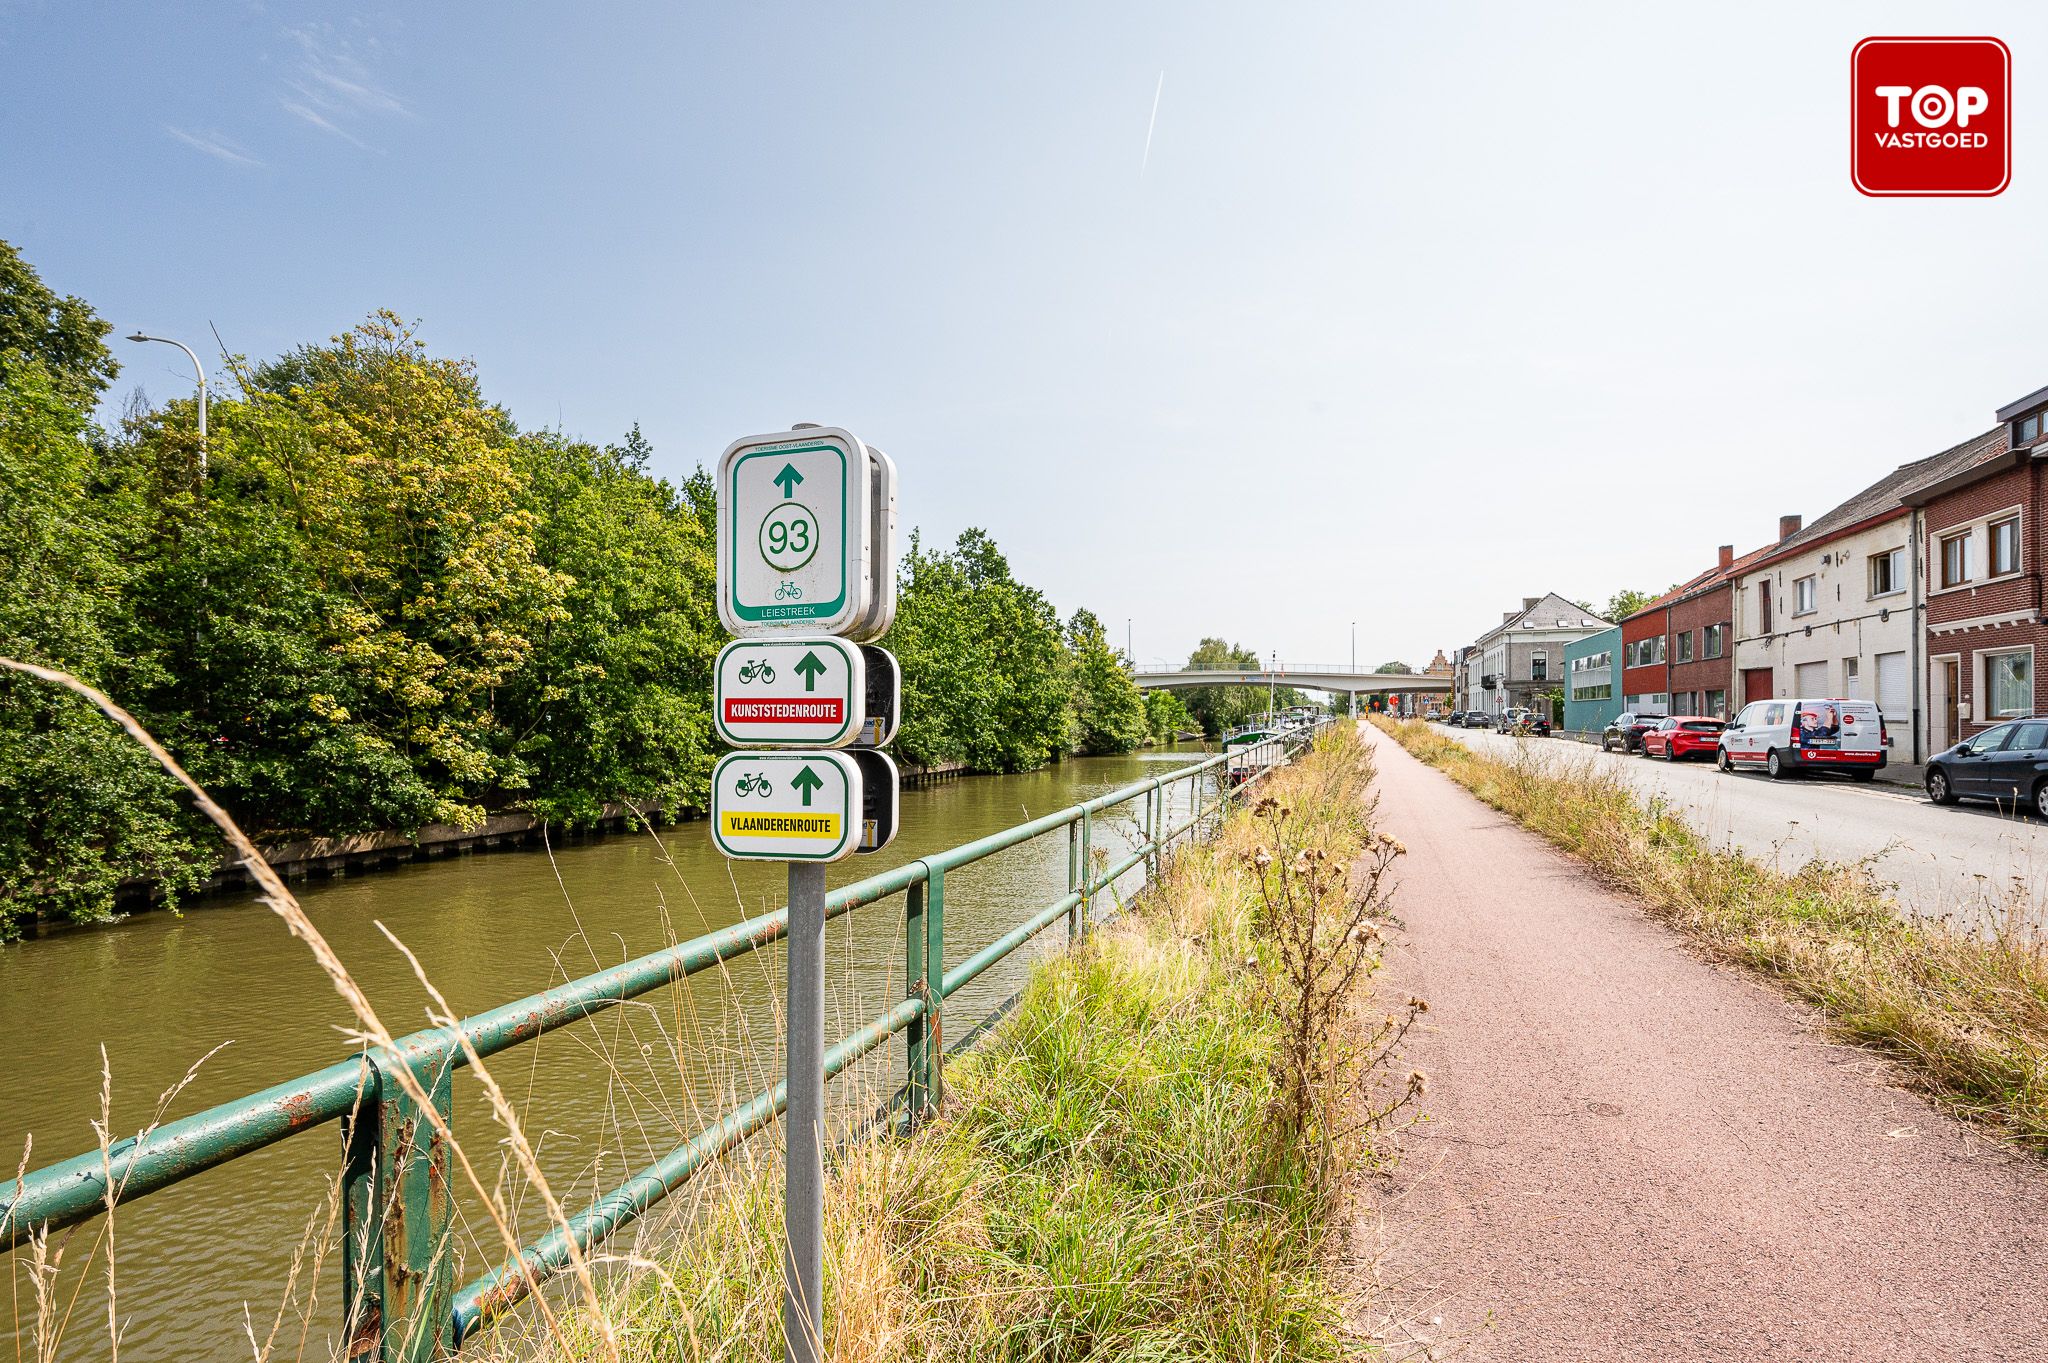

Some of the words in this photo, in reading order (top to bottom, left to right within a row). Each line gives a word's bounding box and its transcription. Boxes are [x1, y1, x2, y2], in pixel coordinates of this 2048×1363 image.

[778, 440, 825, 449] OOST-VLAANDEREN
[768, 519, 810, 555] 93
[761, 606, 816, 617] LEIESTREEK
[731, 703, 837, 718] KUNSTSTEDENROUTE
[730, 817, 831, 833] VLAANDERENROUTE
